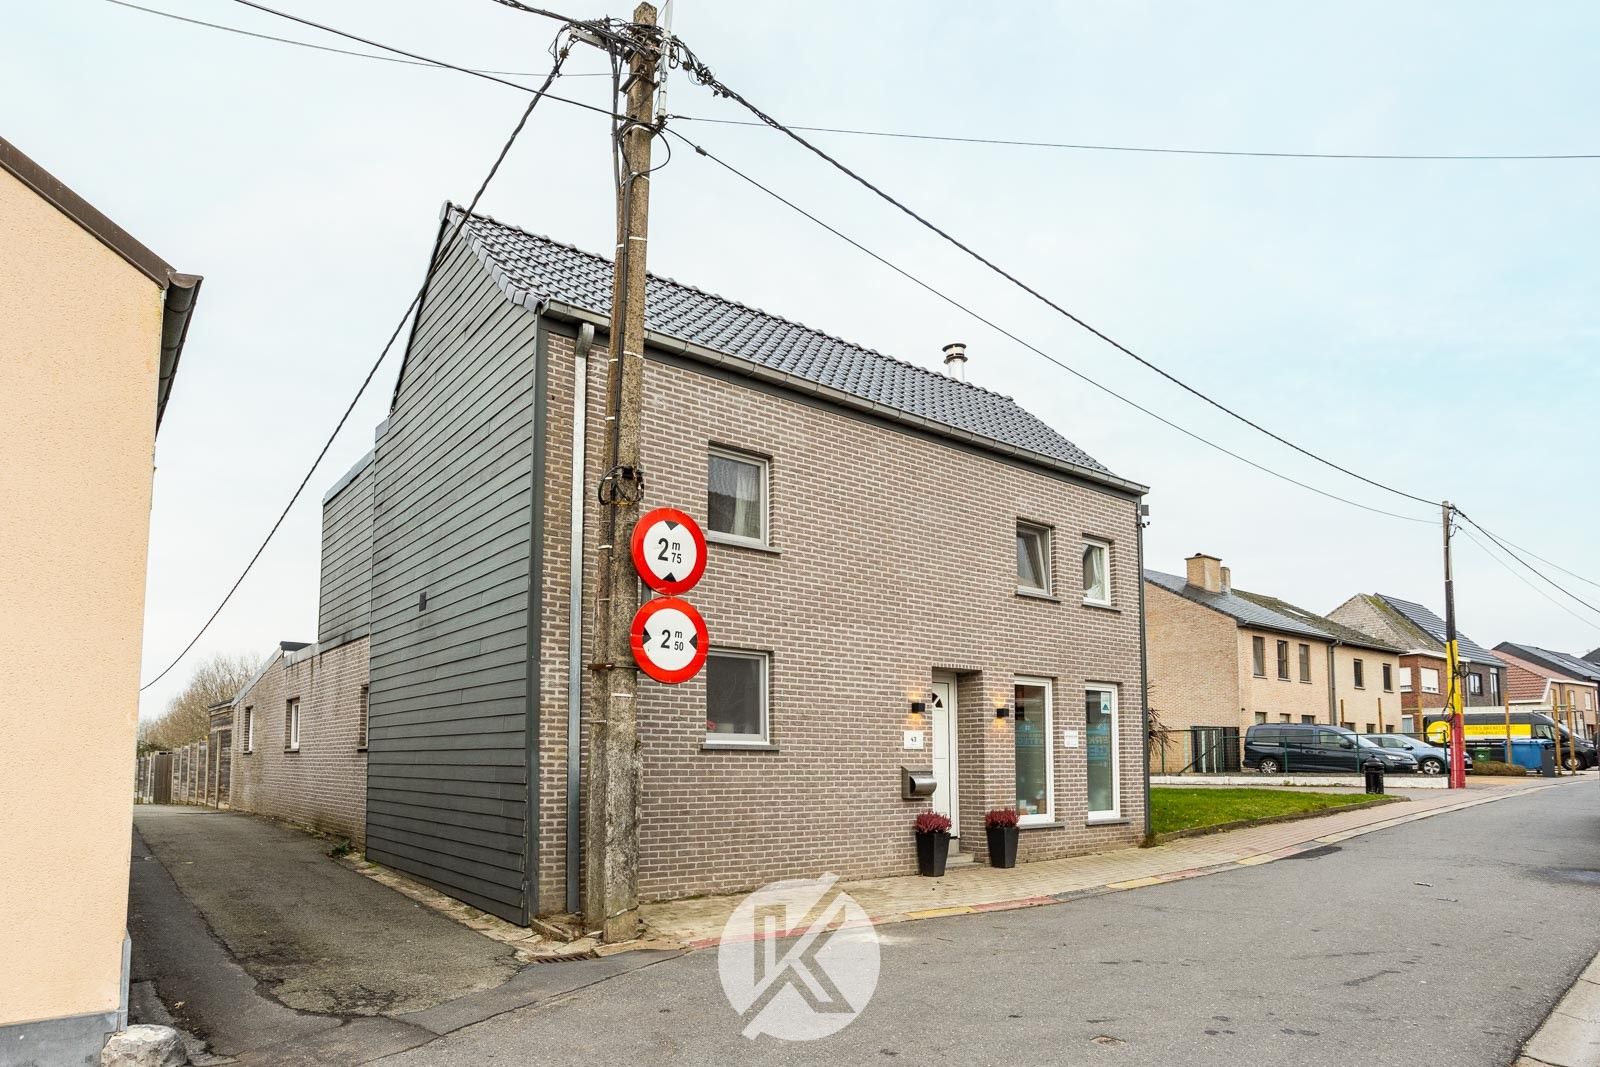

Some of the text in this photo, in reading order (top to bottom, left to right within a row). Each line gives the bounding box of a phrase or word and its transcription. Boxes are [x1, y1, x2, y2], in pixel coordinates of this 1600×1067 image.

[657, 537, 681, 561] 2 m
[671, 552, 682, 564] 75
[660, 629, 682, 649] 2 m
[674, 641, 683, 651] 50
